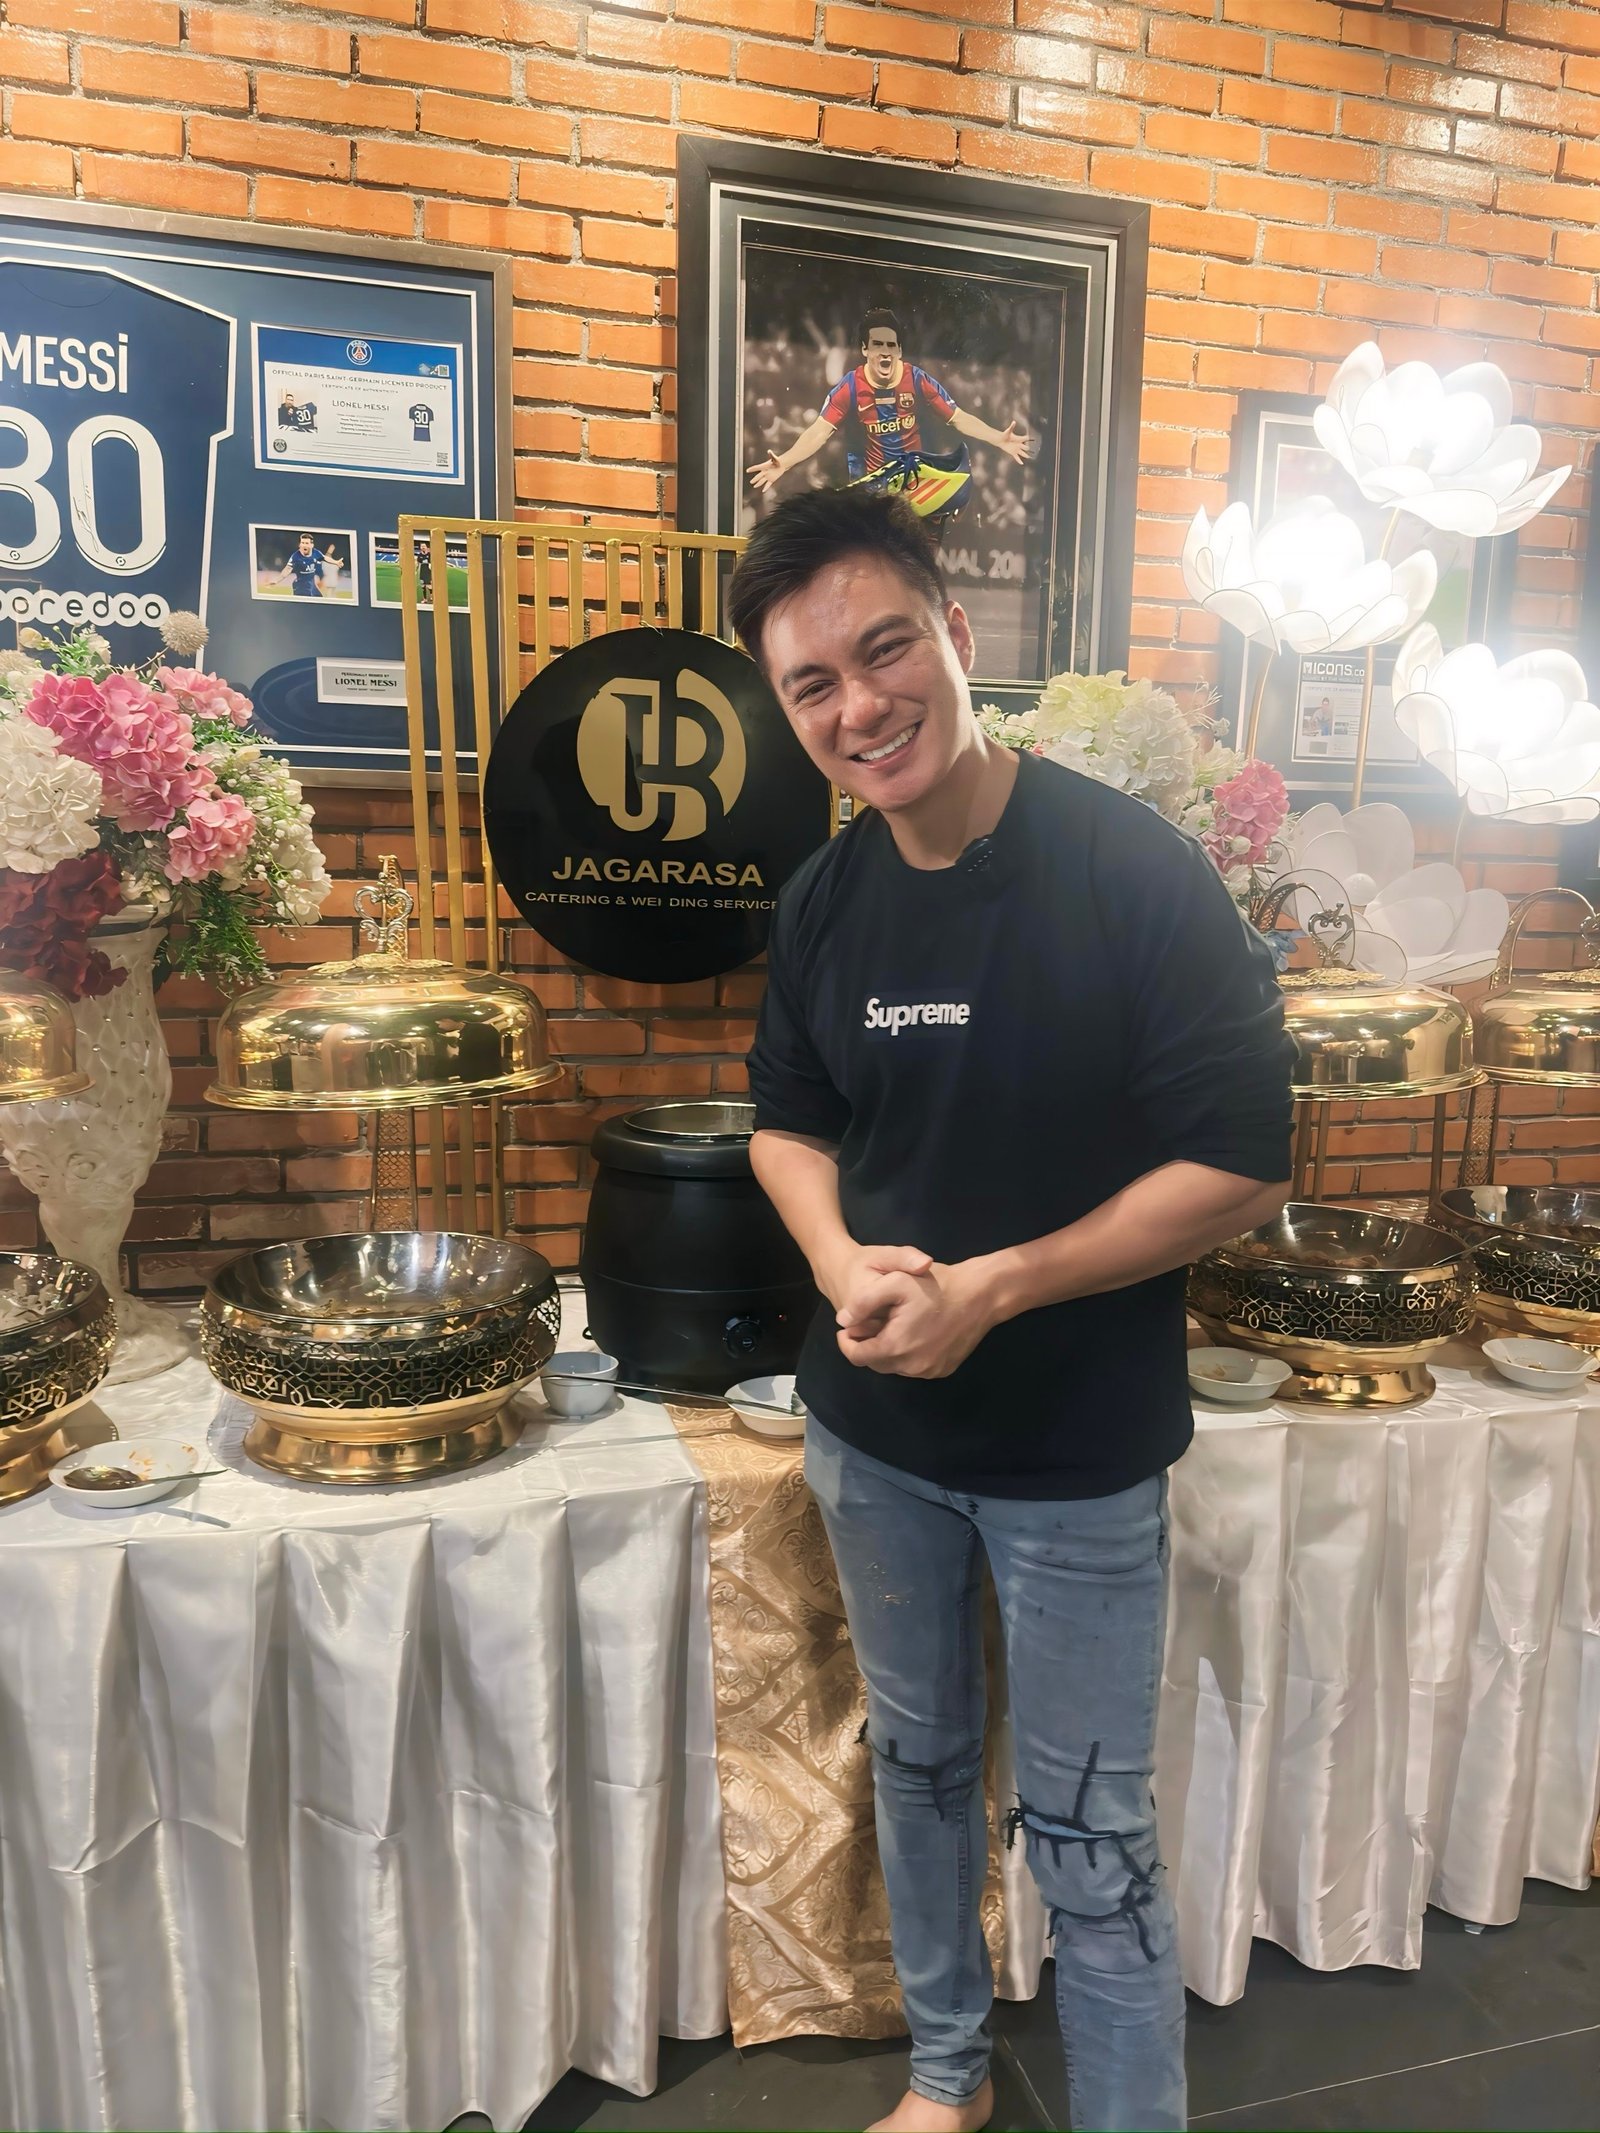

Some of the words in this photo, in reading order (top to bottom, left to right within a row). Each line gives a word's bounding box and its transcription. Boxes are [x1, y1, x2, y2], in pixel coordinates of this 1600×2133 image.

[381, 379, 414, 387] LICENSED
[415, 382, 447, 391] PRODUCT
[332, 400, 362, 409] LIONEL
[363, 403, 390, 411] MESSI
[296, 409, 311, 422] 30
[414, 410, 429, 424] 30
[868, 417, 901, 434] nicef
[934, 546, 985, 578] NAL
[0, 592, 162, 619] oredoo
[335, 678, 368, 686] LIONEL
[552, 856, 764, 887] JAGARASA
[525, 892, 610, 905] CATERING
[615, 896, 627, 905] &
[864, 997, 970, 1036] Supreme
